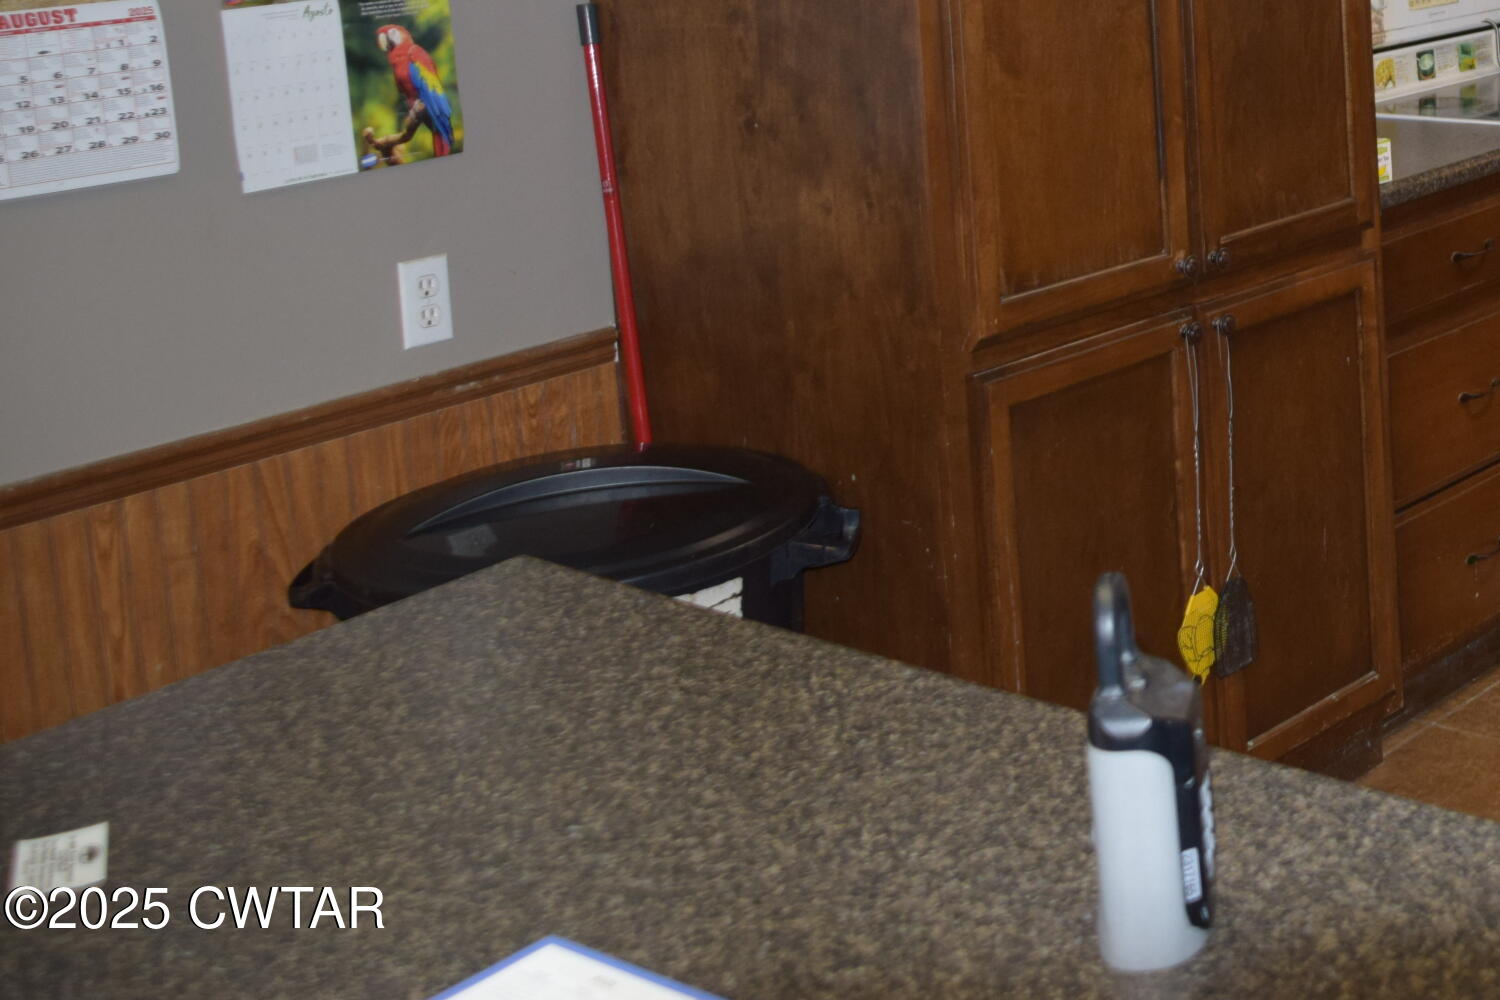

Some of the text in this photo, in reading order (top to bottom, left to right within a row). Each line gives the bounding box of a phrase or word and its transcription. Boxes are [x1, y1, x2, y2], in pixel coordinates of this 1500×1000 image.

[0, 7, 77, 30] AUGUST
[302, 2, 334, 22] Agosto
[88, 67, 96, 76] 7
